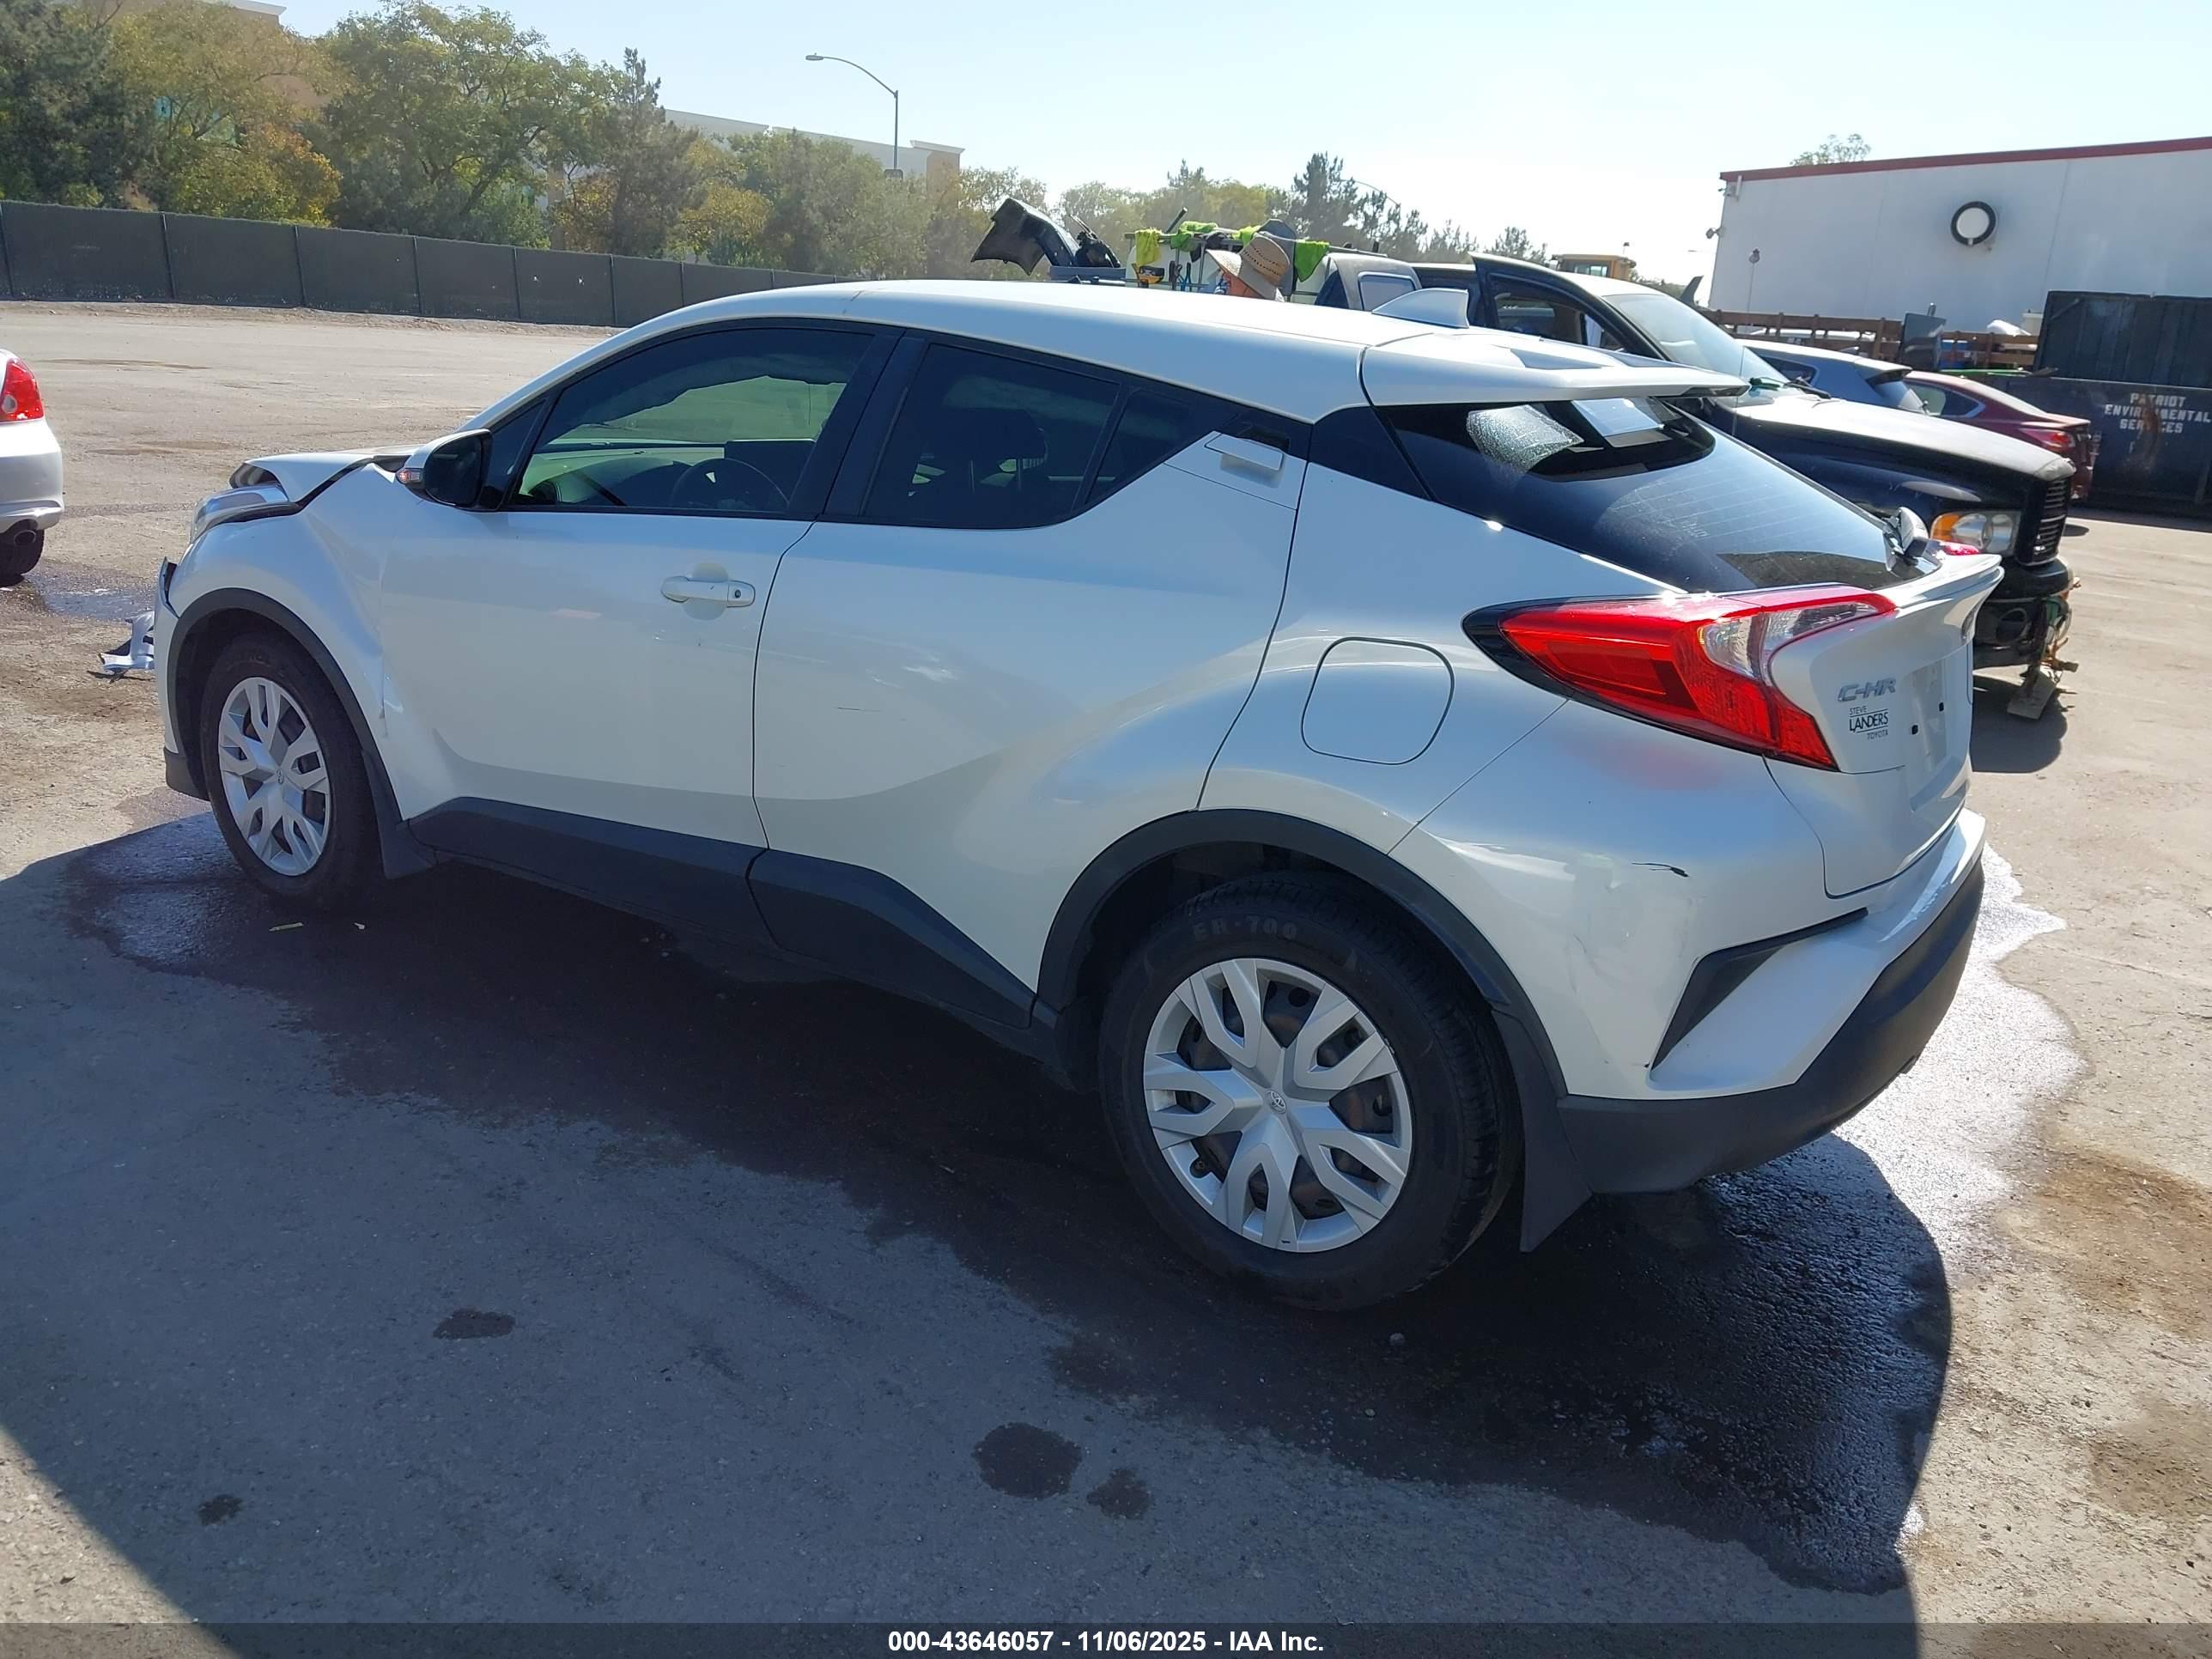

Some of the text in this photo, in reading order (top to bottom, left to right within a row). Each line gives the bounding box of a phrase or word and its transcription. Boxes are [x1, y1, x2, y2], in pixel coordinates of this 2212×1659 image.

[2130, 392, 2186, 407] PATRIOT
[2104, 404, 2212, 423] ENVIRMENTAL
[2119, 418, 2184, 434] SERES
[1838, 678, 1896, 702] C-HR
[1849, 705, 1868, 715] STEVE
[1849, 712, 1889, 732] LANDERS
[1867, 729, 1888, 740] TOYOTA
